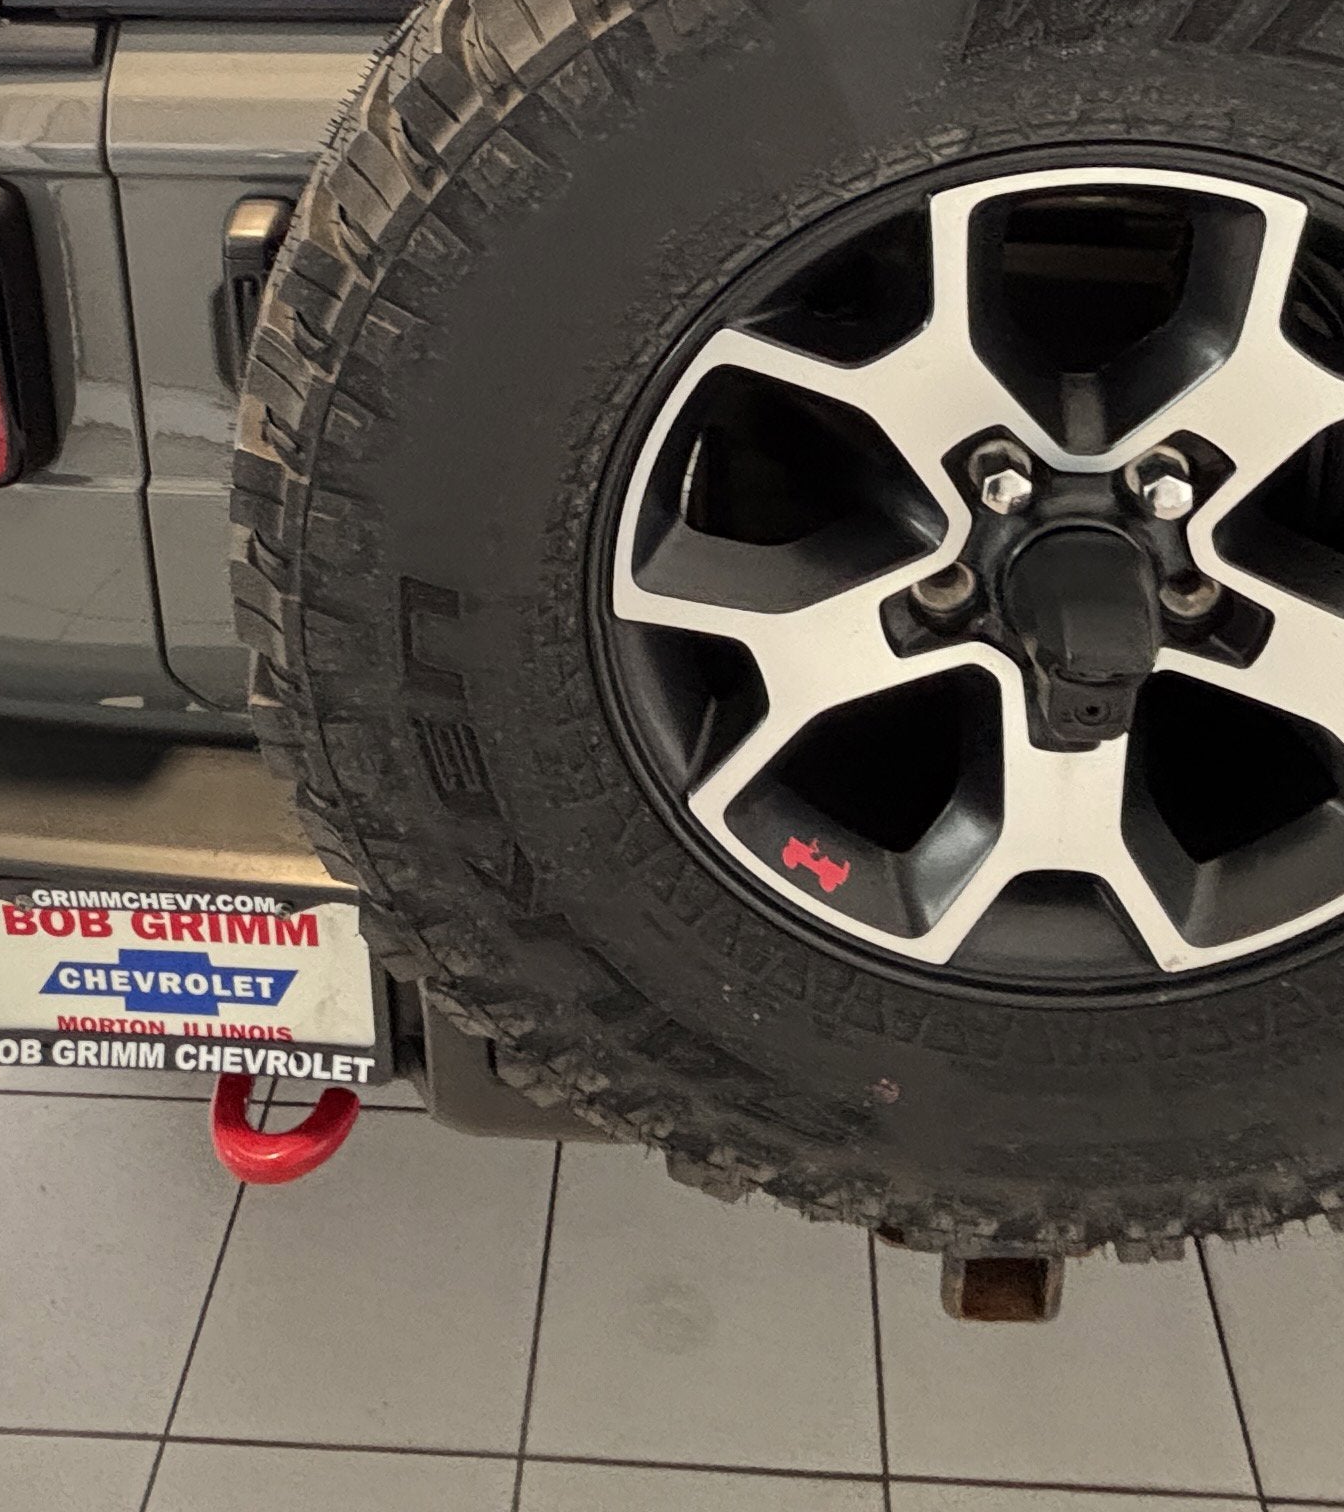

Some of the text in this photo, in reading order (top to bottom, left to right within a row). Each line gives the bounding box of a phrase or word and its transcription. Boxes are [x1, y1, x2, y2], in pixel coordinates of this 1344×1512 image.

[32, 889, 276, 913] GRIMMCHEVY.COM
[2, 904, 319, 947] BOB GRIMM
[58, 967, 274, 999] CHEVROLET
[57, 1015, 294, 1042] MORTON ILLINOIS
[52, 1039, 166, 1069] GRIMM
[175, 1043, 375, 1083] CHEVROLET
